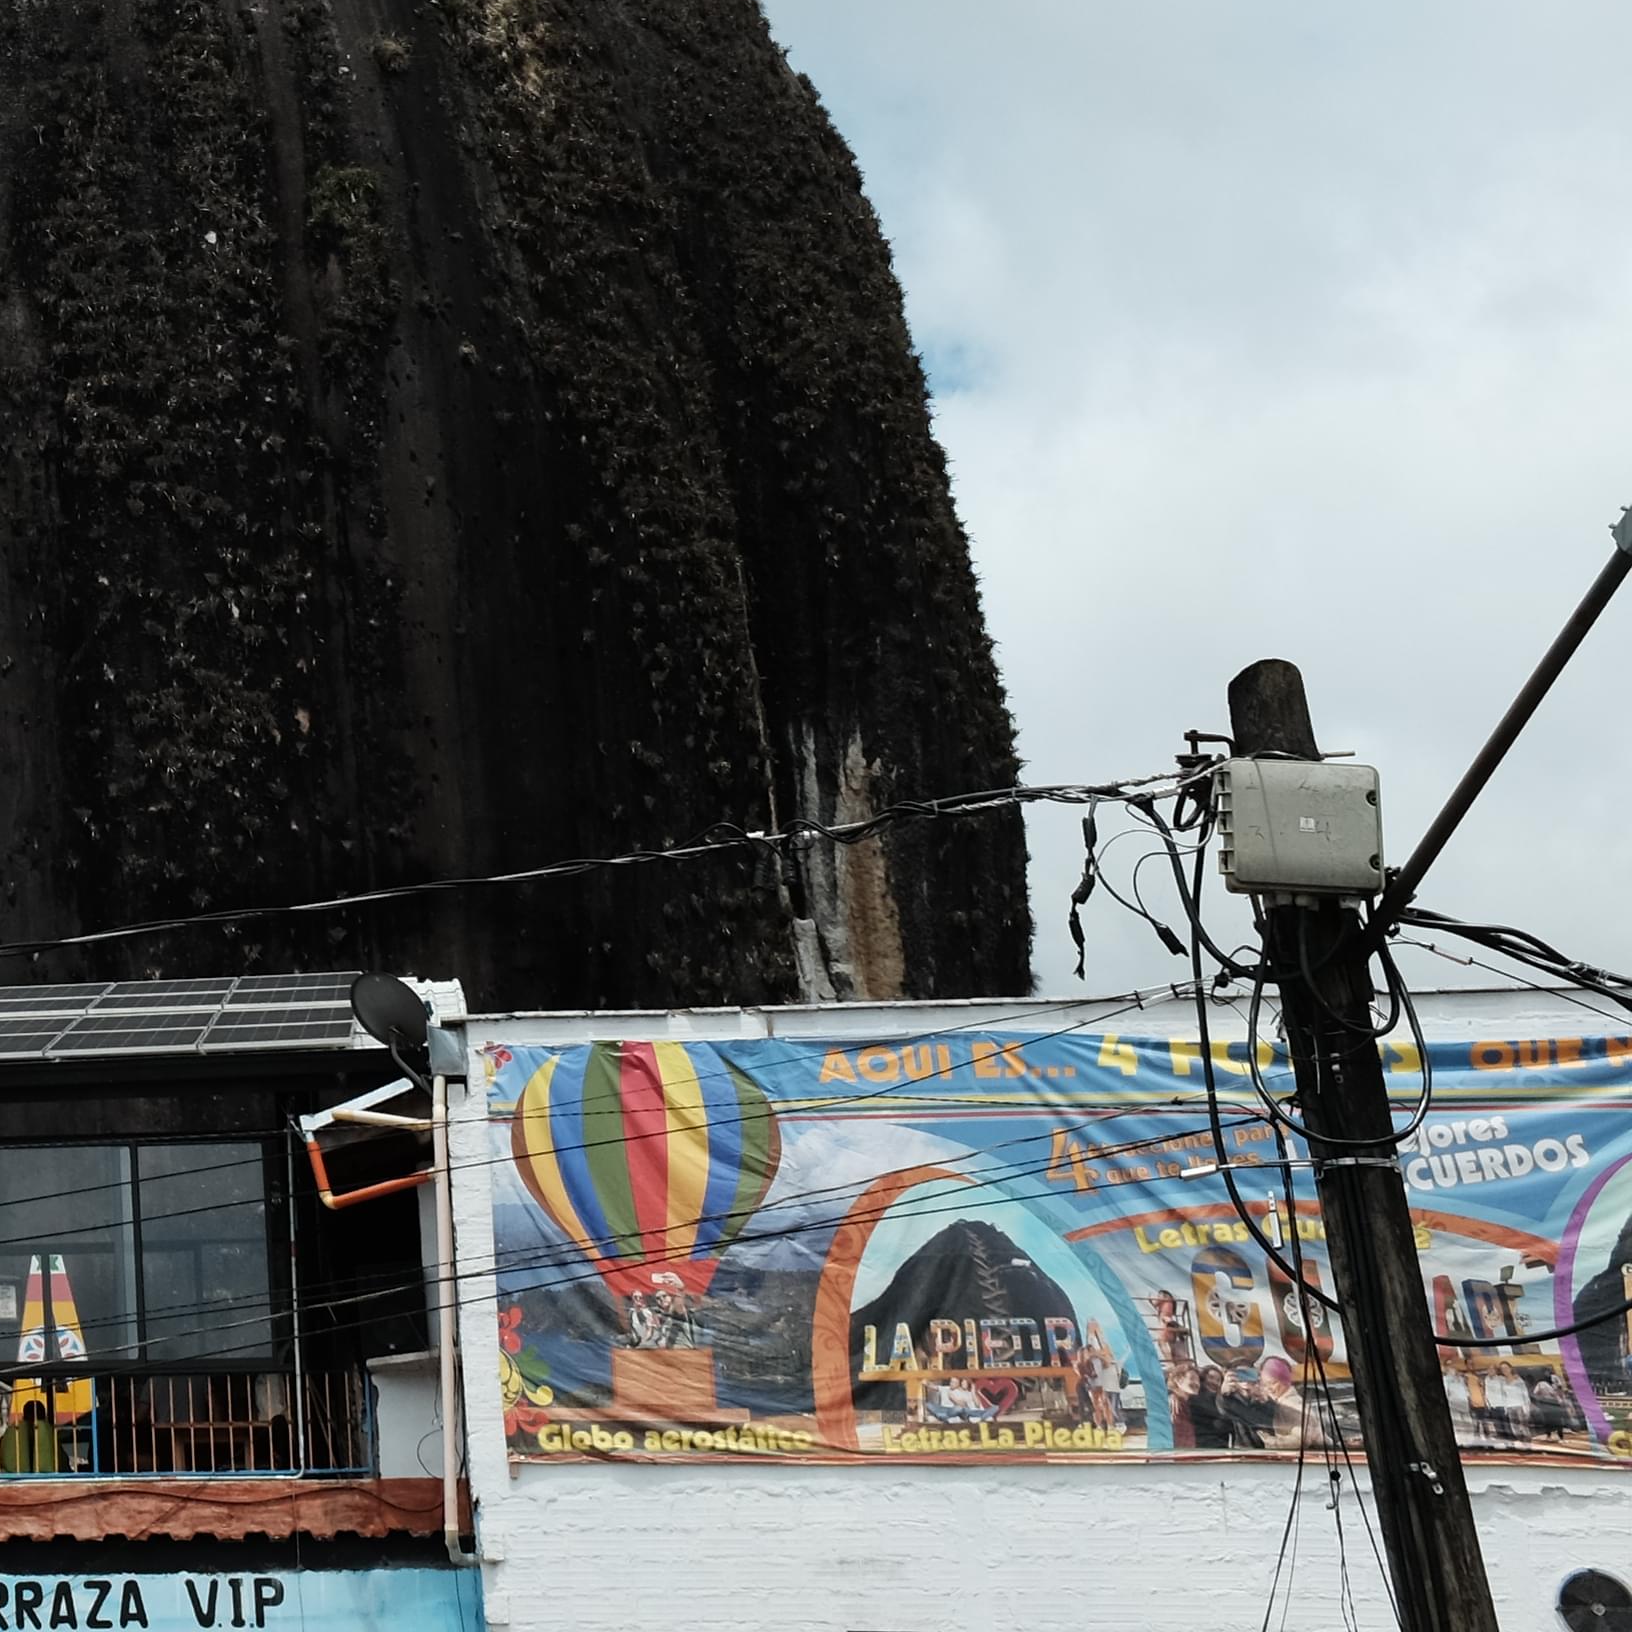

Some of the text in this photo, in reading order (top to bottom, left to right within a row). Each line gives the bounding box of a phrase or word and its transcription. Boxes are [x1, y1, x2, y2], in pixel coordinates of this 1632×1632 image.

[819, 1043, 953, 1083] AQUI
[1097, 1032, 1138, 1076] 4
[1469, 1036, 1586, 1072] QUE
[1396, 1116, 1508, 1157] ejores
[1046, 1128, 1100, 1196] 4
[1106, 1167, 1150, 1184] que
[1404, 1134, 1590, 1193] CUERDOS
[1134, 1219, 1249, 1254] Letras
[864, 1322, 918, 1372] LA
[538, 1423, 634, 1453] Globo
[883, 1419, 1124, 1451] Letras La Piedra
